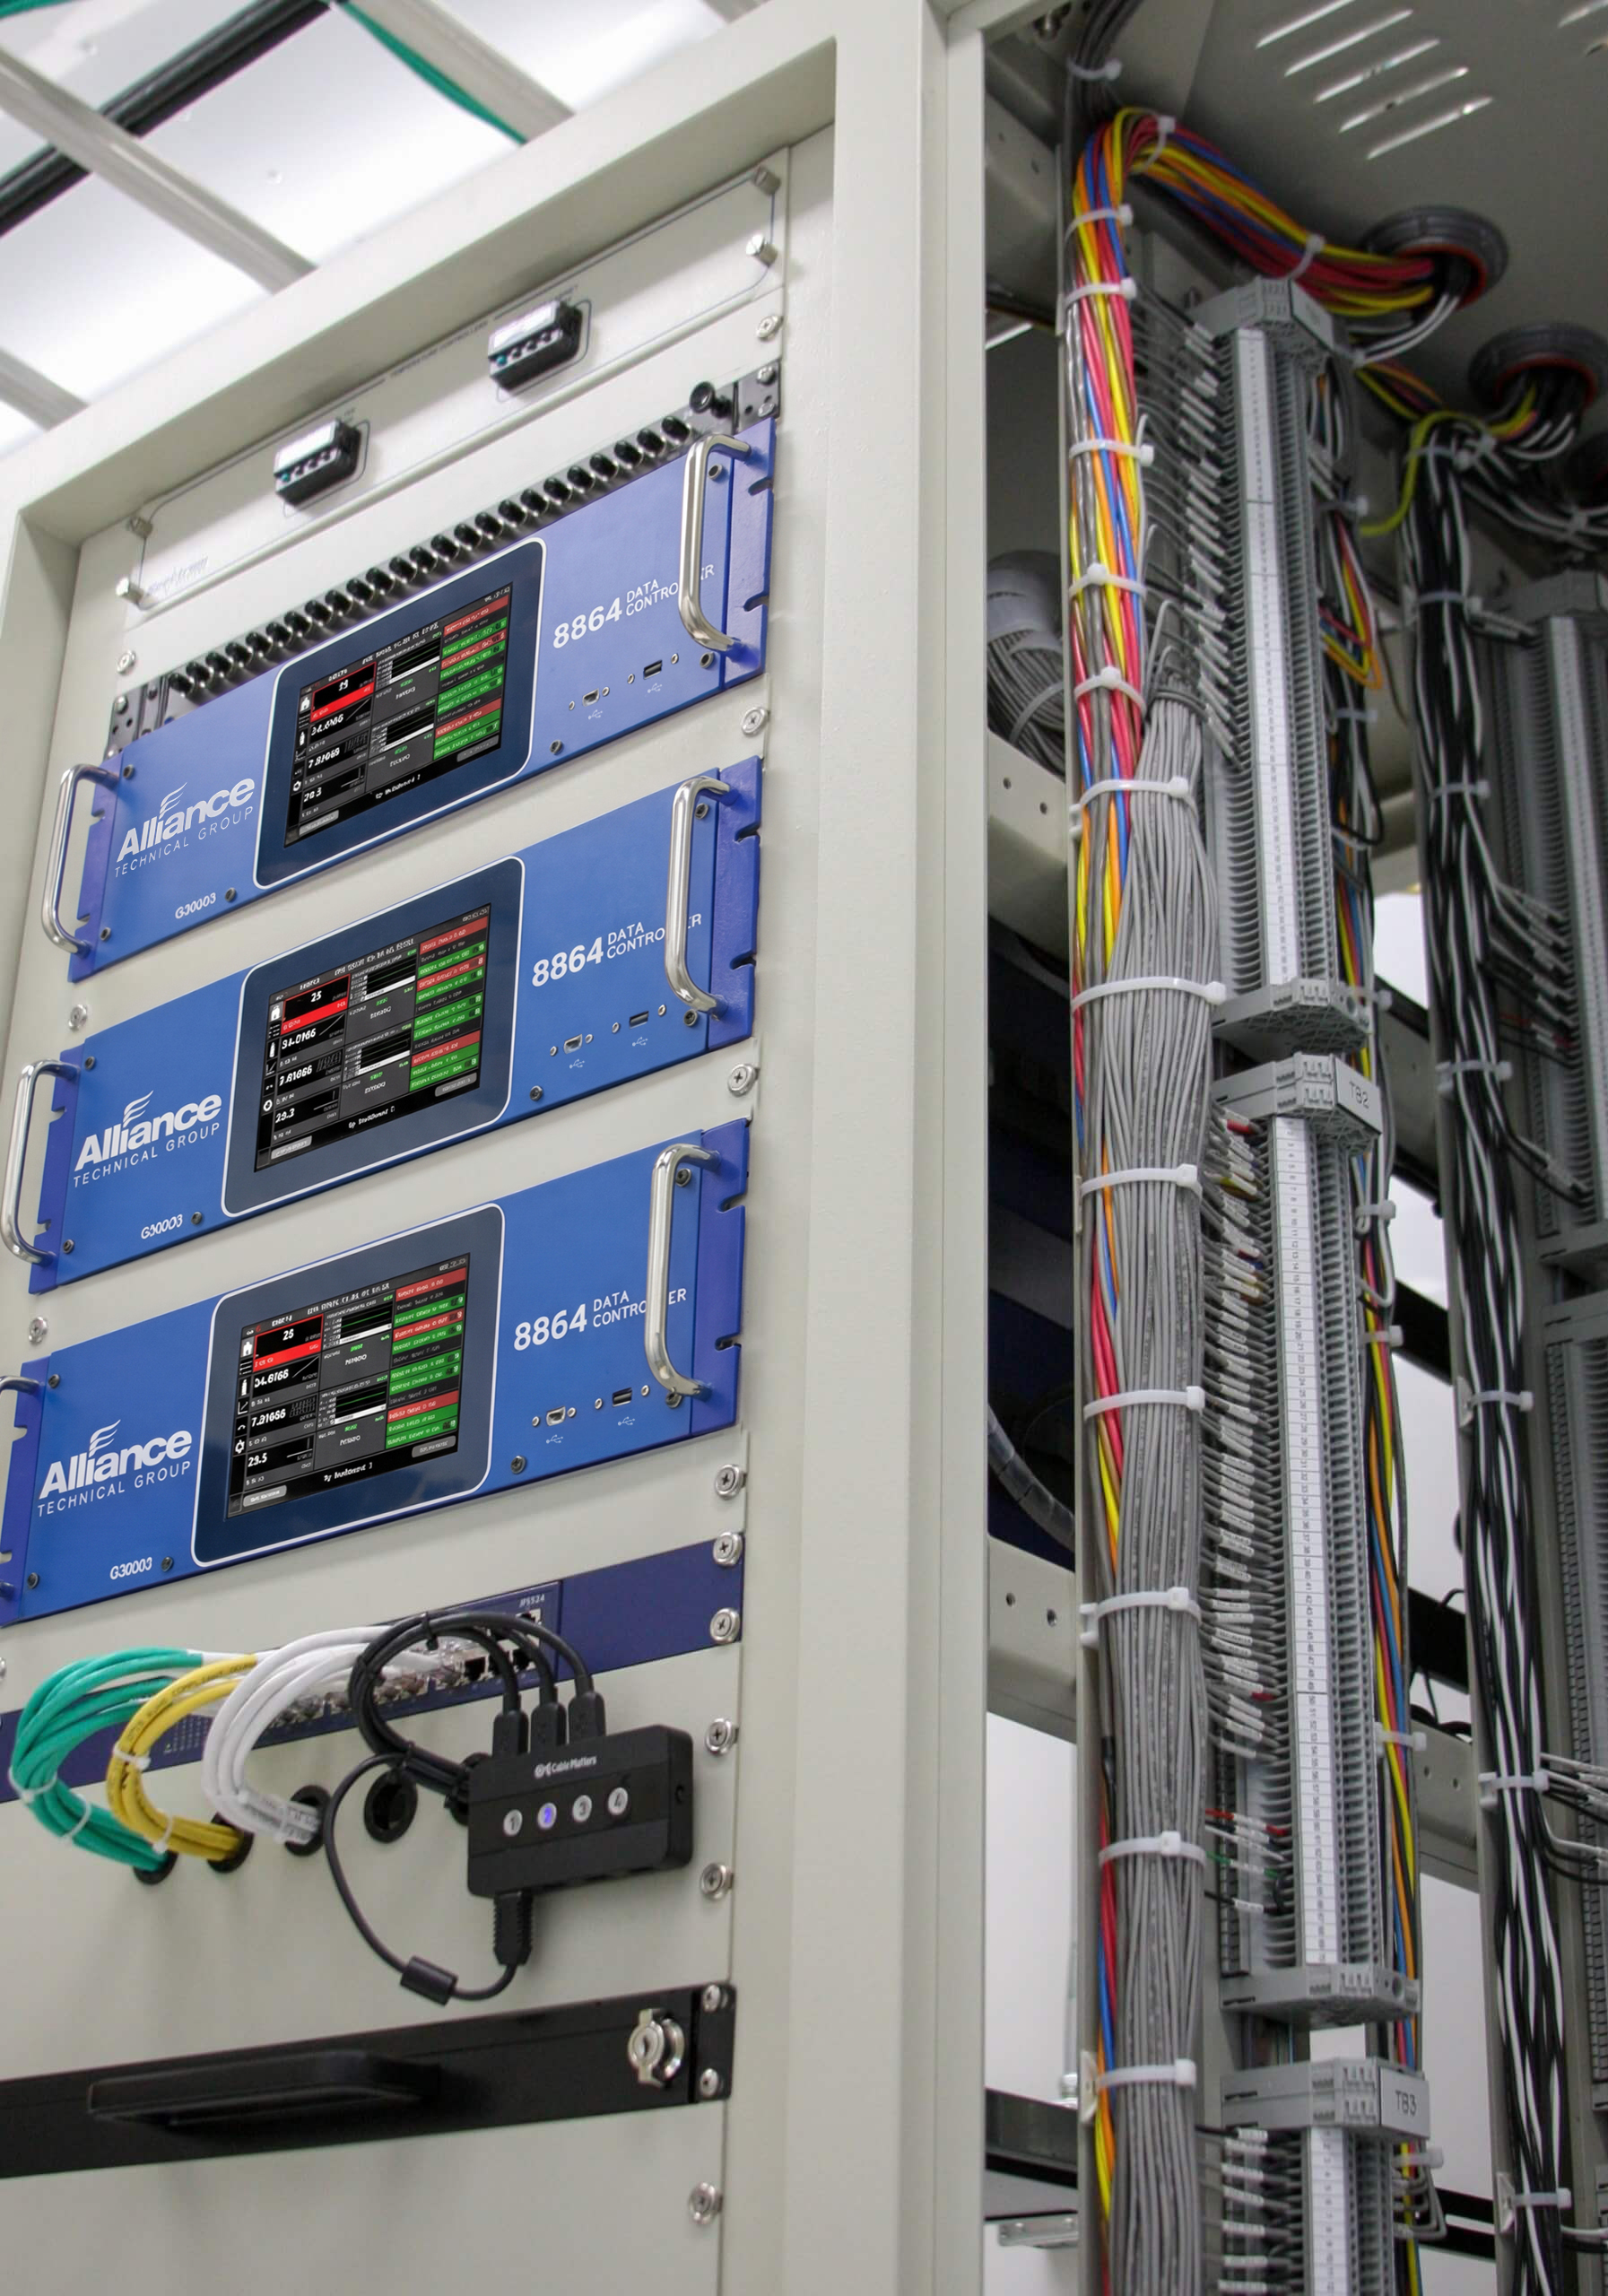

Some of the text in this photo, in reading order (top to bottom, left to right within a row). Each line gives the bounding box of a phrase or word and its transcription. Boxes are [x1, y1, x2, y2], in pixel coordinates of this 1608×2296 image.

[552, 564, 715, 648] 8864 CONTROR
[627, 578, 659, 603] DATA
[115, 806, 253, 877] TECHNICAL GROUP
[117, 778, 255, 863] Alliance
[532, 913, 702, 987] 8864 CONTROR
[607, 921, 644, 945] DATA
[1349, 1081, 1369, 1109] TB2
[74, 1091, 222, 1171] Alliance
[74, 1122, 220, 1188] TECHNICAL GROUP
[514, 1288, 687, 1351] 8864 CONTROER
[593, 1290, 630, 1312] DATA
[37, 1460, 191, 1517] TECHNICAL GROUP
[39, 1426, 192, 1500] Alliance
[109, 1556, 152, 1580] G30003
[579, 1801, 587, 1816] 3
[1395, 2090, 1417, 2117] TB3
